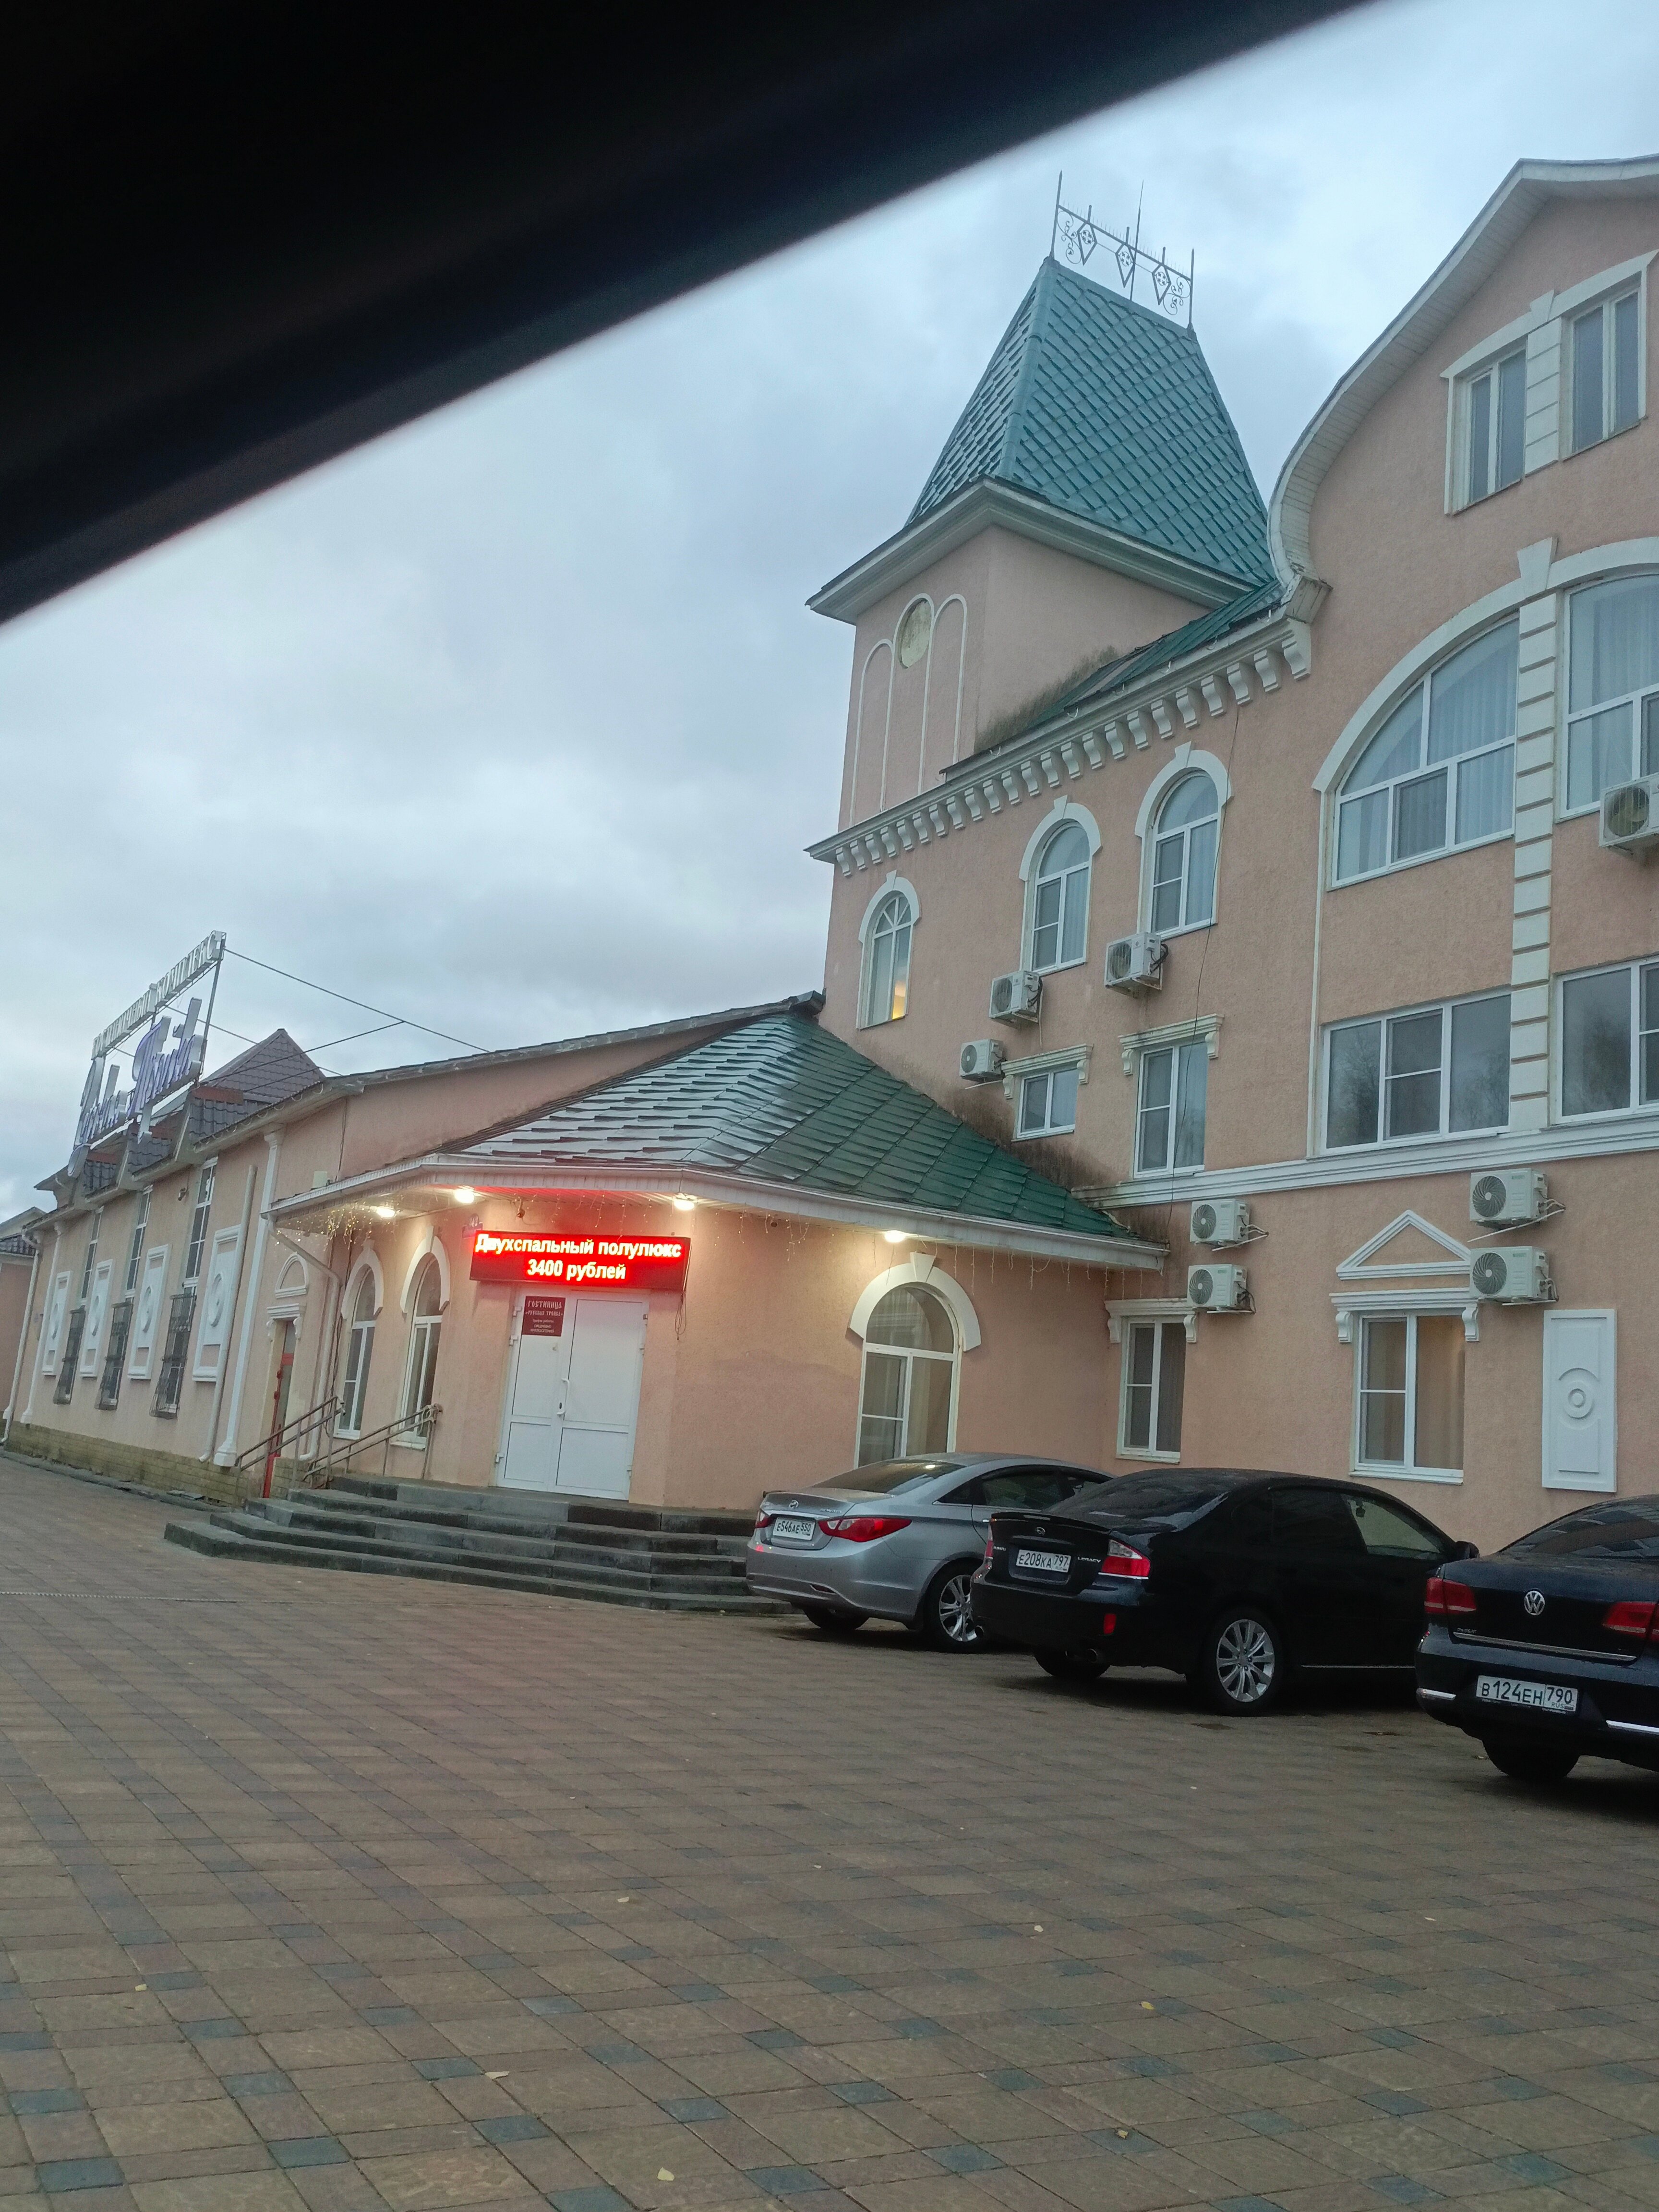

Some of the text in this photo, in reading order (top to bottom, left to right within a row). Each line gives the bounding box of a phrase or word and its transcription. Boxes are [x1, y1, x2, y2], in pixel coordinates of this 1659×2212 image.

[155, 930, 225, 1007] КОМПЛЕКС
[475, 1233, 682, 1260] Двухспальный полулюкс
[527, 1259, 626, 1281] 3400 рублей
[528, 1300, 562, 1309] ГОСТИНИЦА
